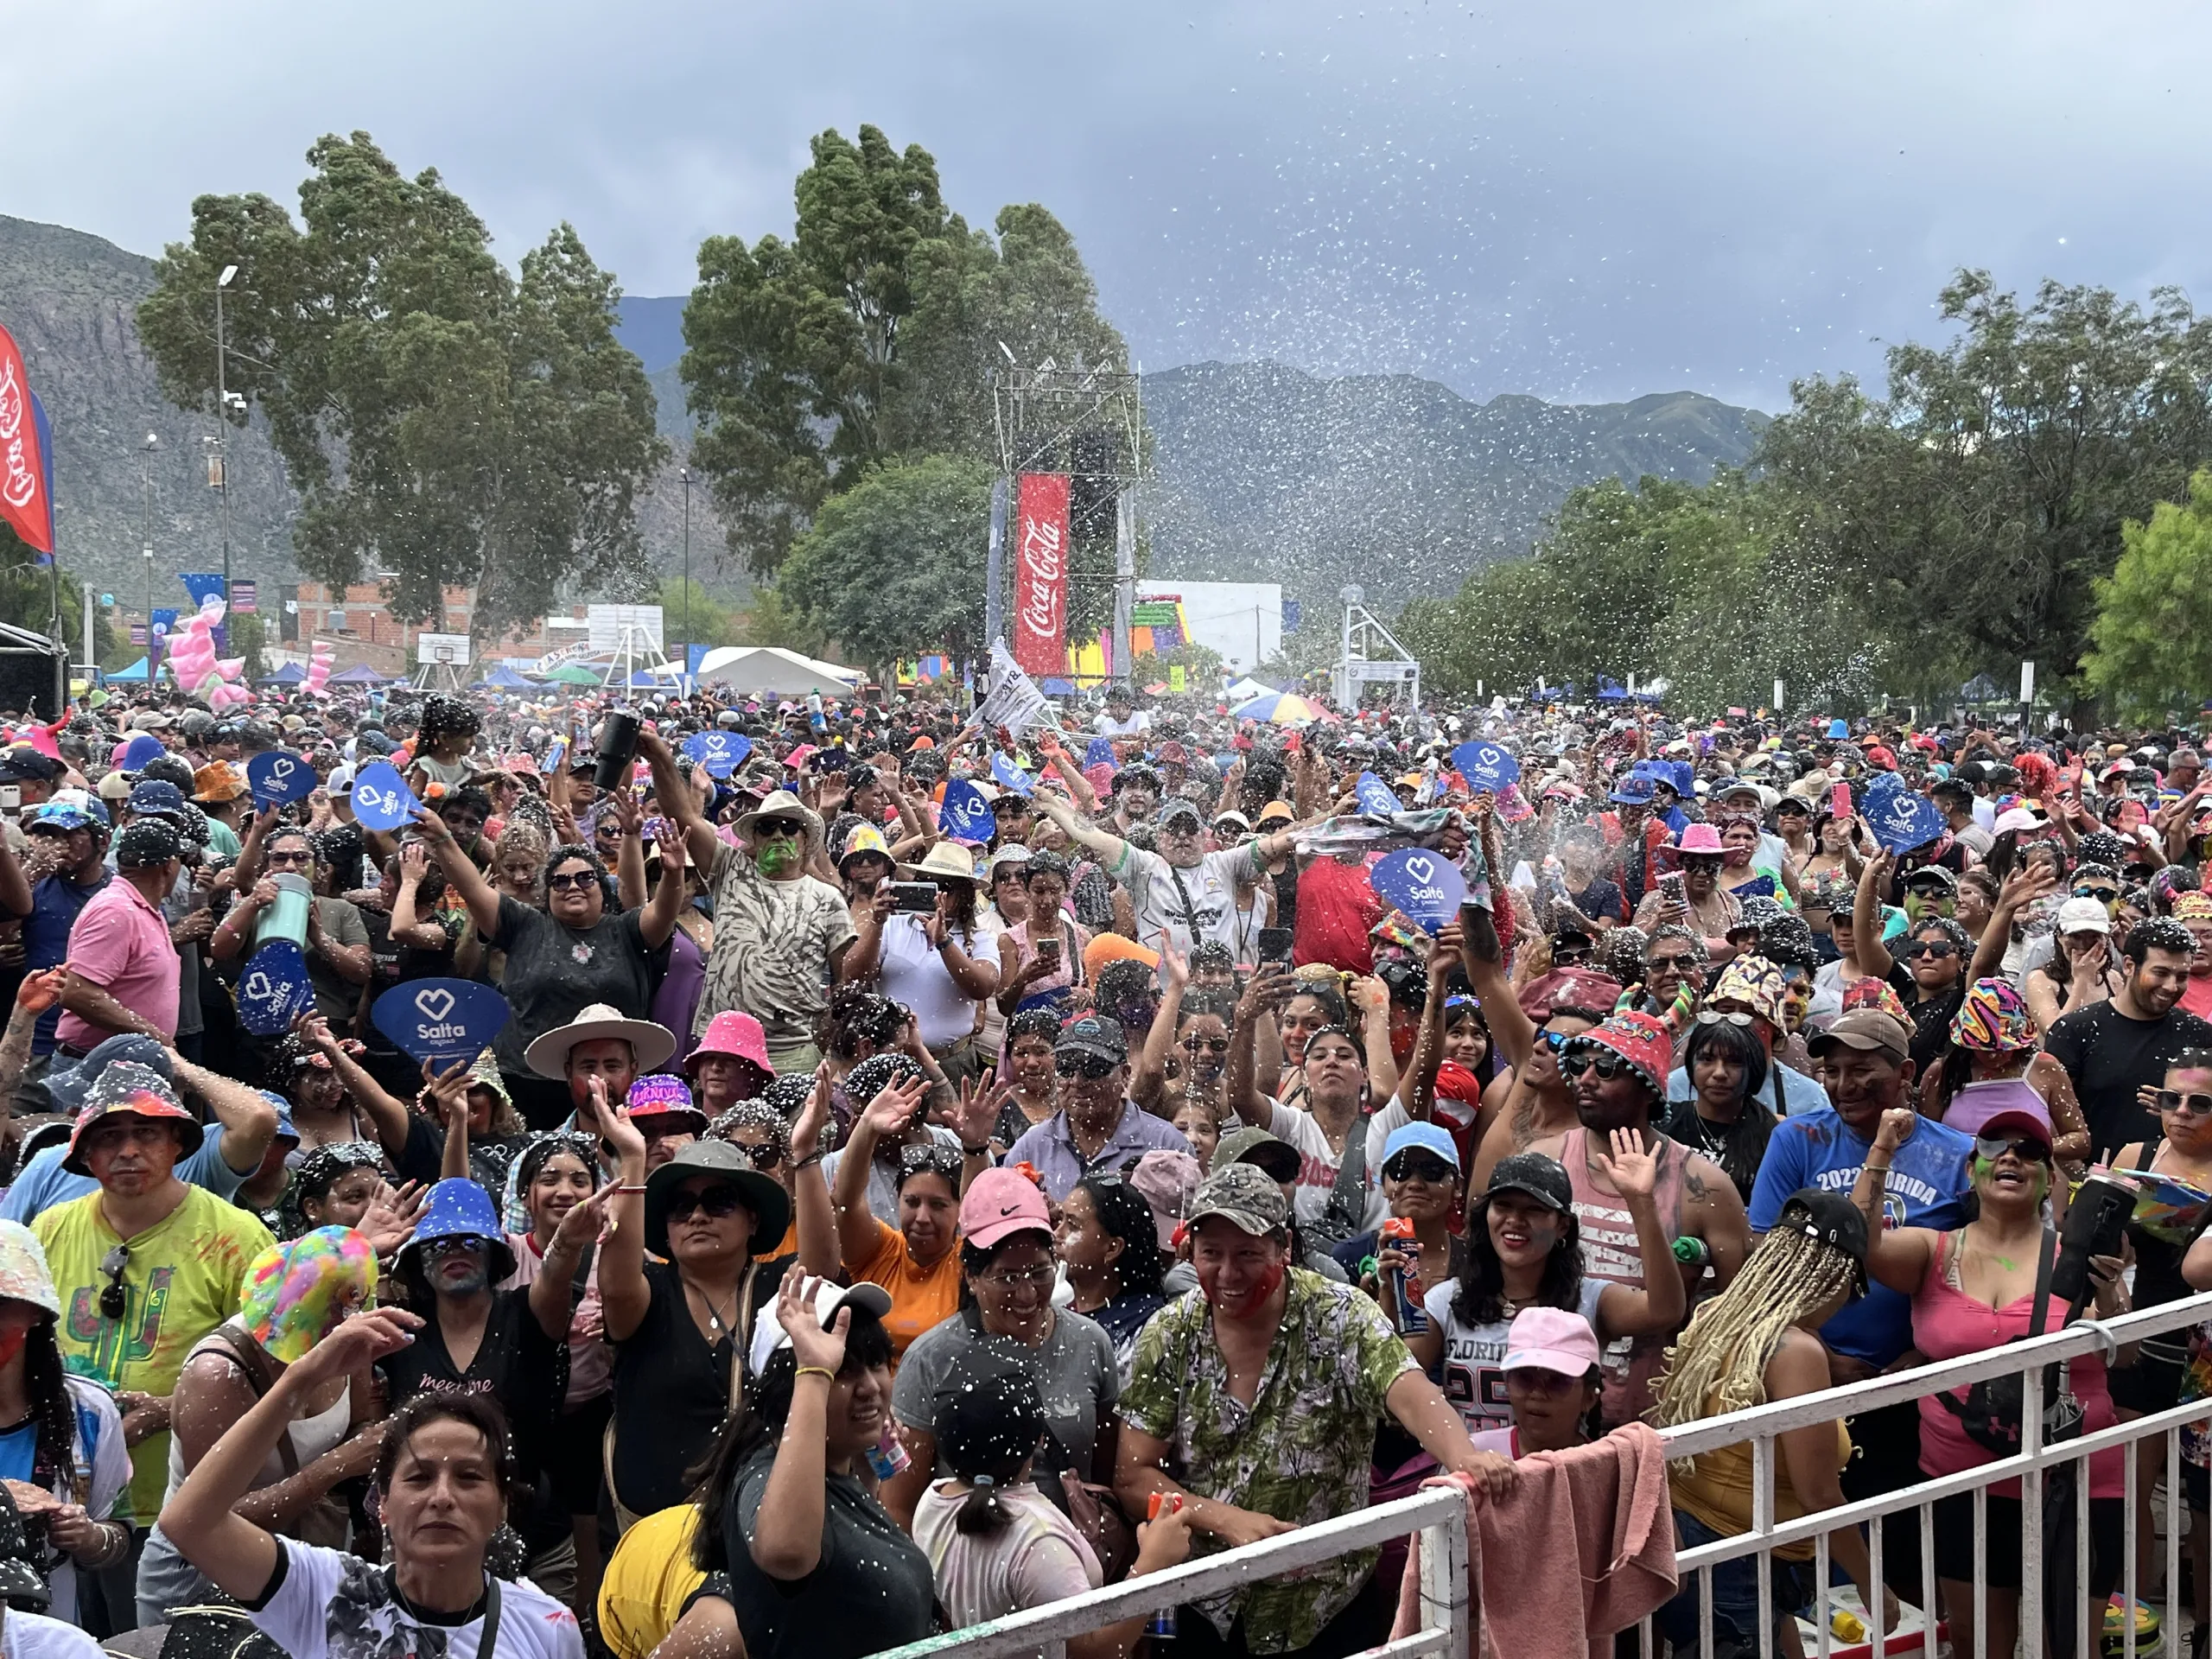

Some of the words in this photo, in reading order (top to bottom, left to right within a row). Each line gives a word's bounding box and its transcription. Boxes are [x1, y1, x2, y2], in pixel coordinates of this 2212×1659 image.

[1023, 514, 1059, 638] Coca-Cola
[1474, 763, 1500, 779] Salta
[263, 776, 289, 791] Salta
[380, 791, 397, 816] Salta
[954, 804, 972, 828] Salta
[1884, 815, 1915, 833] Salta
[267, 982, 293, 1016] Salta
[417, 1023, 466, 1039] Salta
[1885, 1171, 1937, 1206] ORIDA
